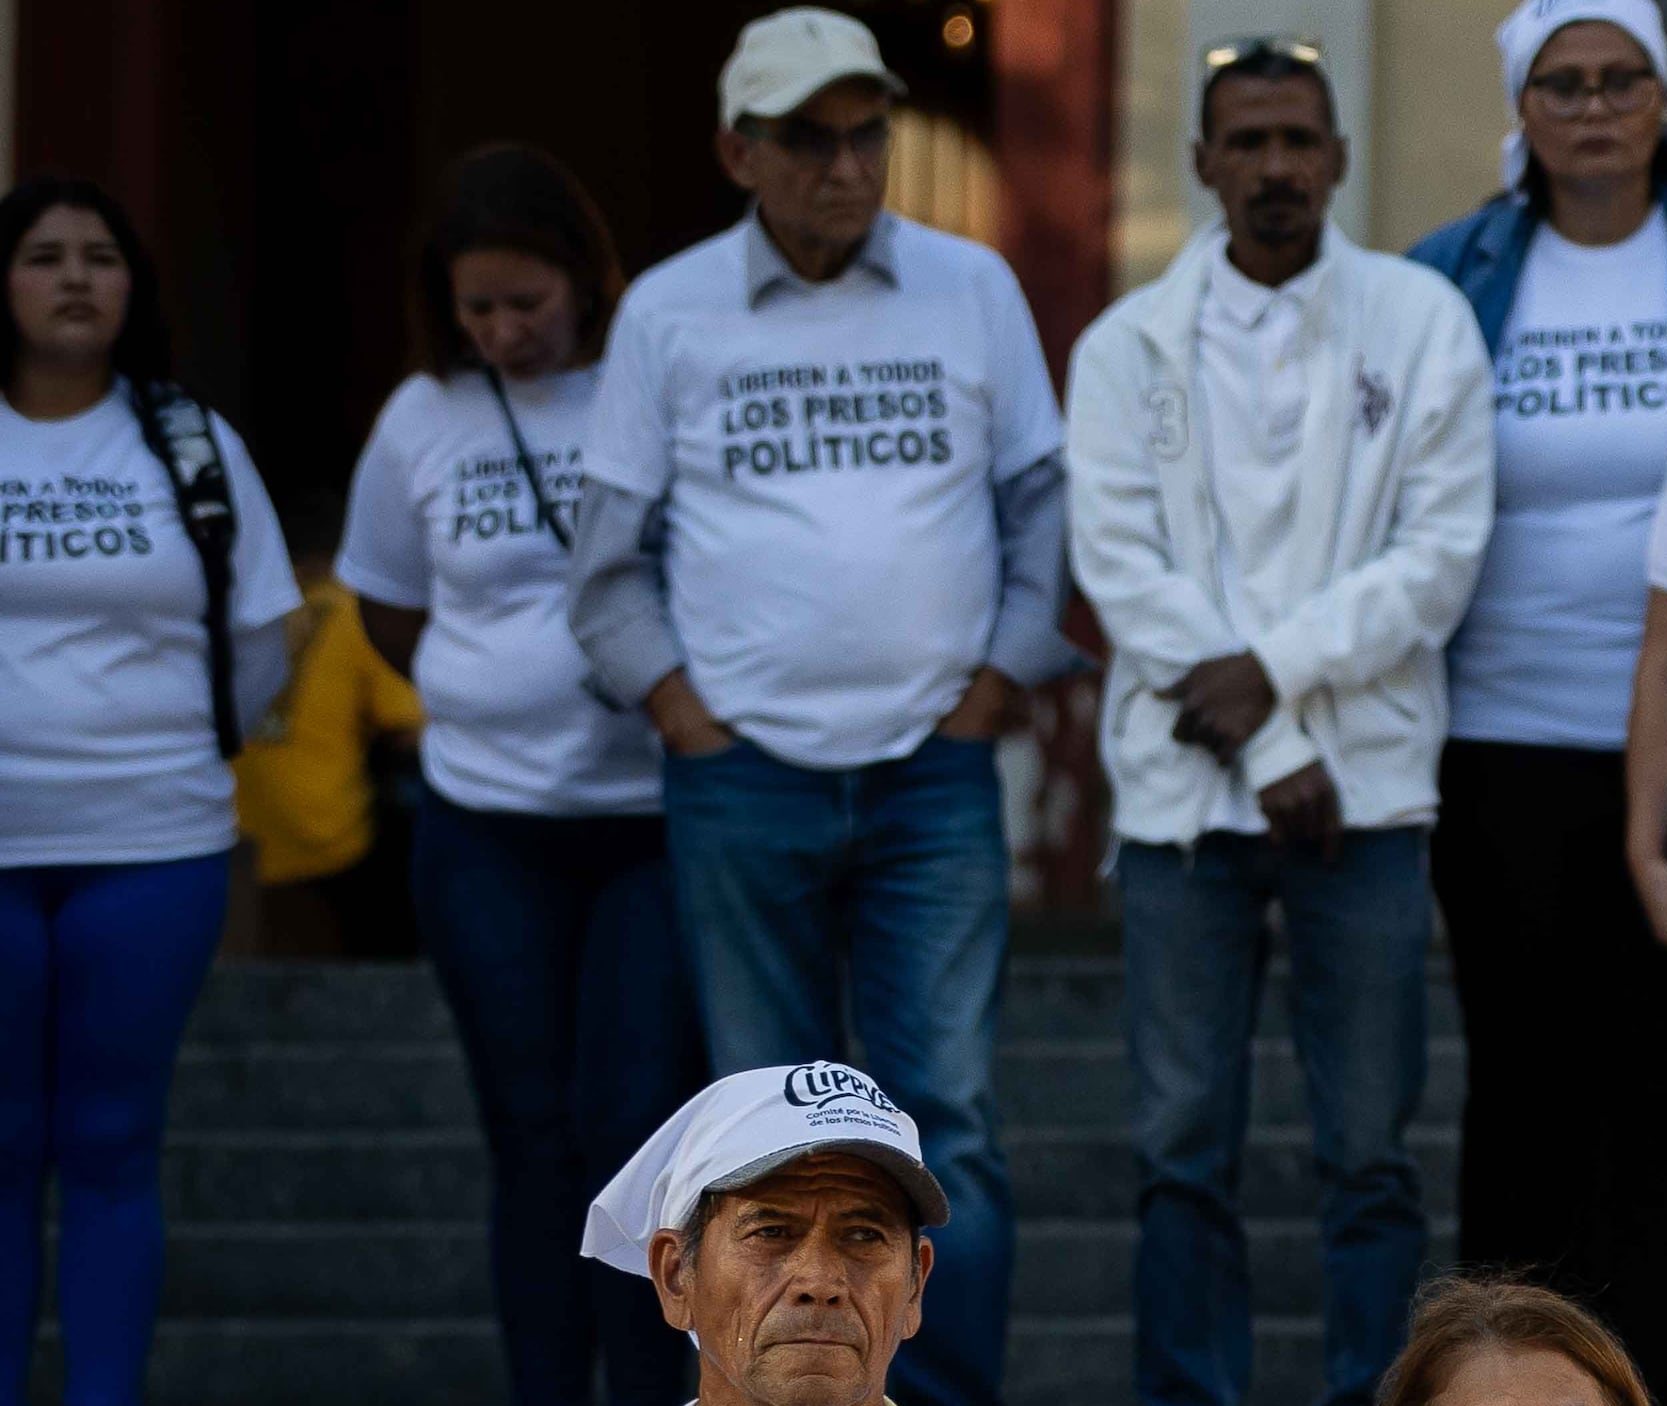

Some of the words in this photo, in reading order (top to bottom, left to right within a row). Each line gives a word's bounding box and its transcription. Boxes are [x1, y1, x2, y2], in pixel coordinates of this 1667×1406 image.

[859, 358, 944, 385] TODOS
[725, 398, 790, 436] LOS
[806, 388, 948, 427] PRESOS
[724, 424, 953, 480] POLÍTICOS
[0, 518, 153, 563] ÍTICOS
